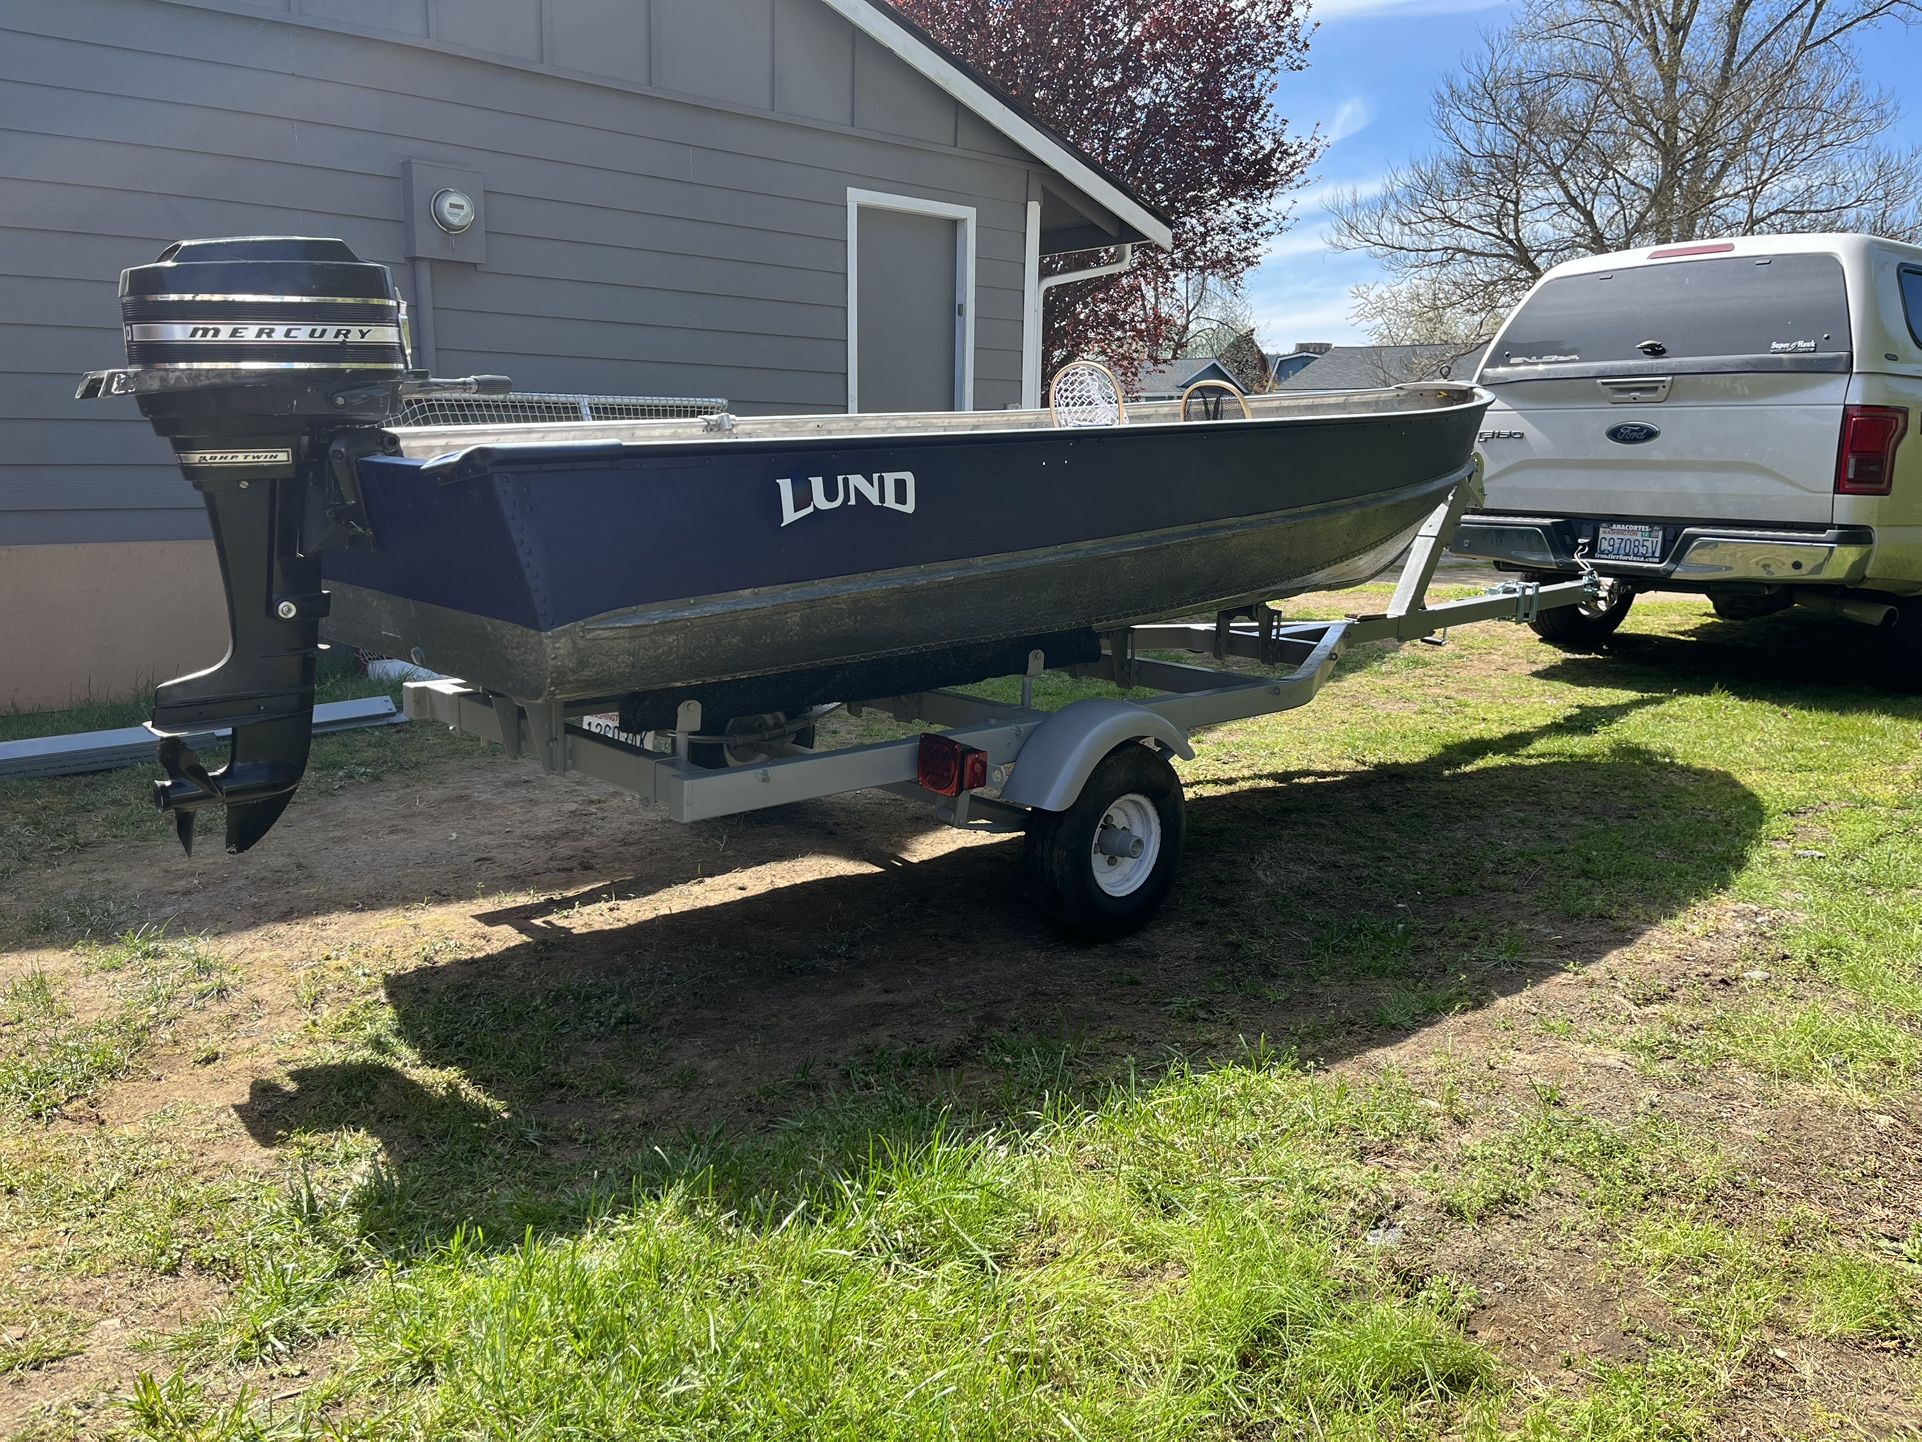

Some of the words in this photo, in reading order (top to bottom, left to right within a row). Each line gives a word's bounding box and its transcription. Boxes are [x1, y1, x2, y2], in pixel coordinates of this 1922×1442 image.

[188, 326, 375, 340] MERCURY
[1616, 425, 1646, 440] Ford
[775, 471, 916, 527] LUND
[1611, 524, 1650, 532] ANACORTES
[1598, 537, 1659, 556] C97085V
